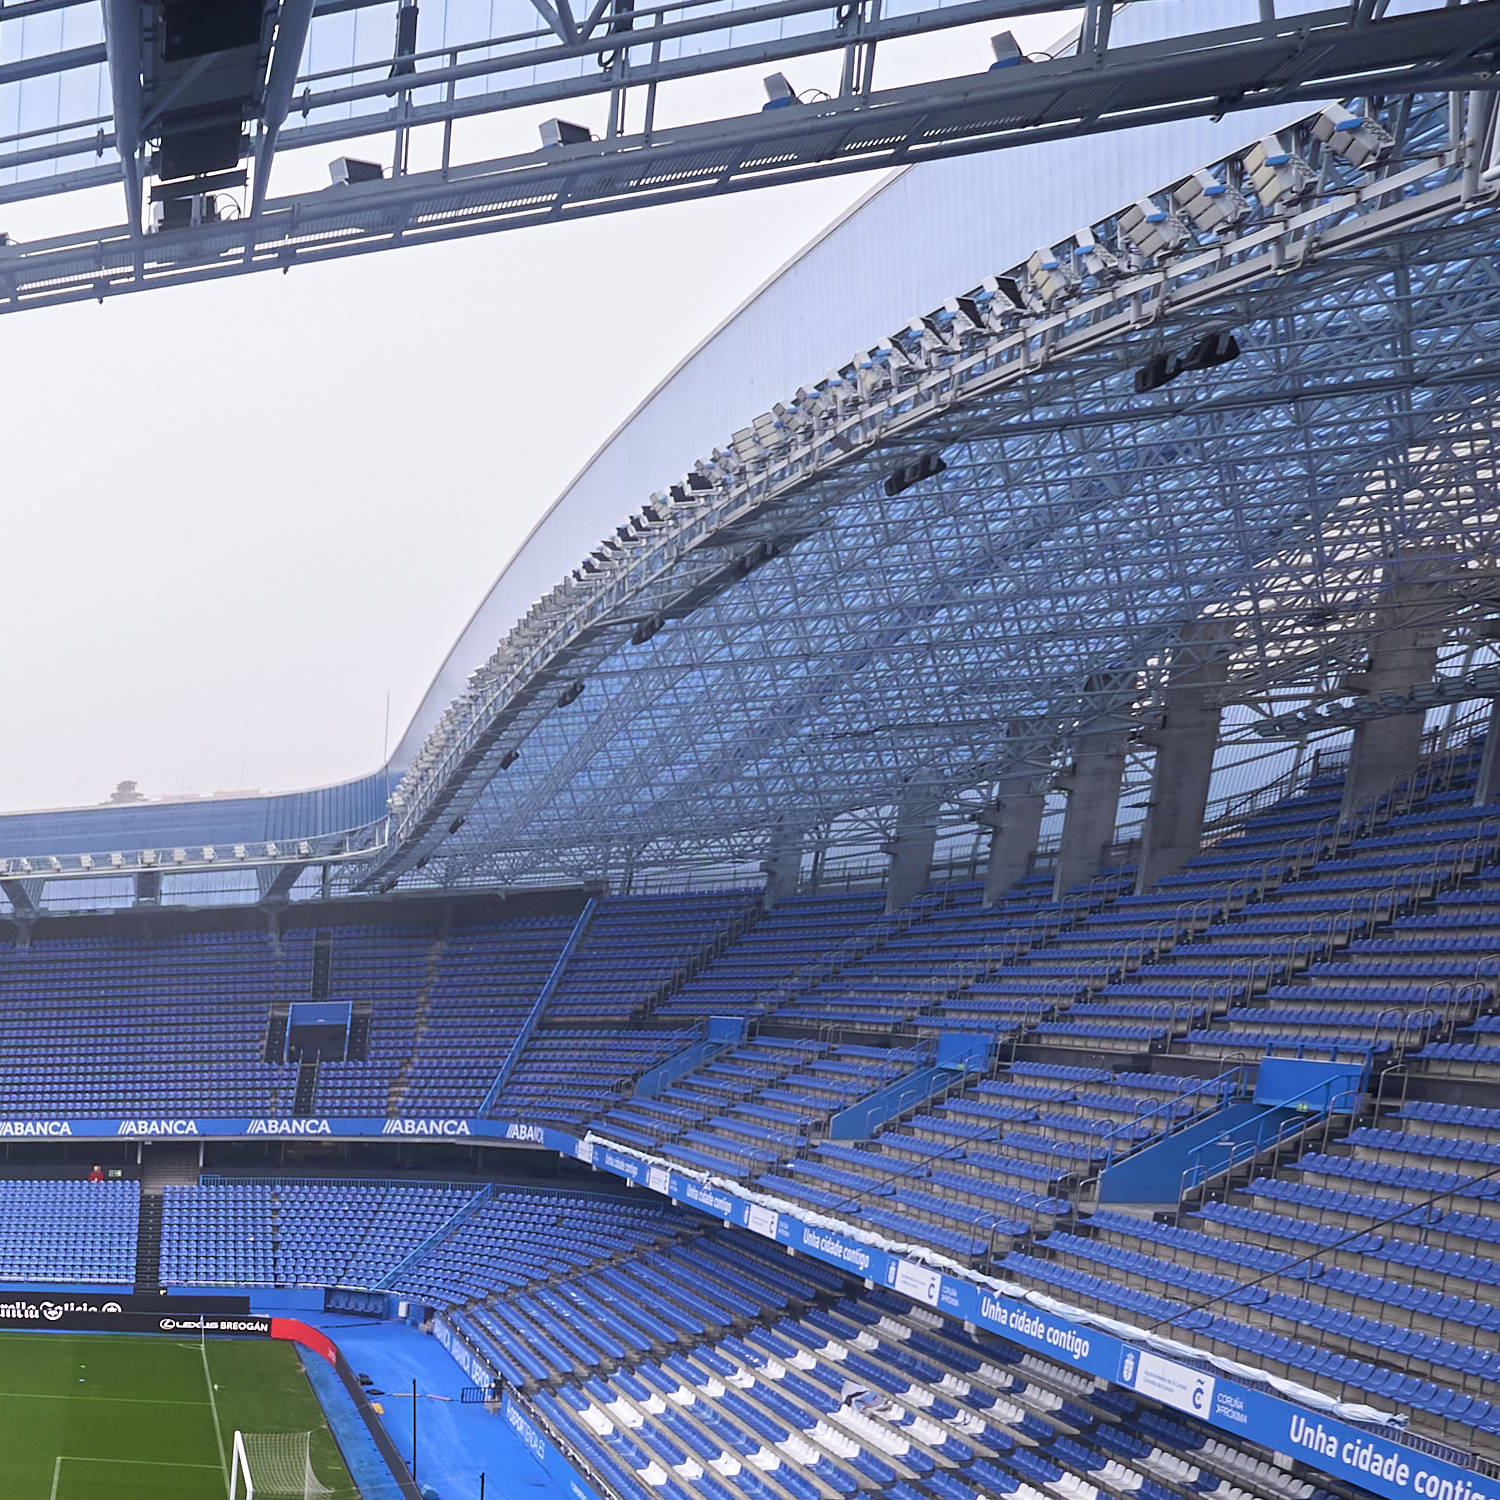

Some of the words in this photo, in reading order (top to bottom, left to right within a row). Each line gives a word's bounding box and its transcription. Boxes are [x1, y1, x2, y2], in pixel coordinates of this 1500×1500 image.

[802, 1228, 821, 1246] Unha
[821, 1232, 843, 1257] cidade
[843, 1244, 870, 1271] contigo
[220, 1321, 268, 1332] BREOGÁN
[981, 1299, 1008, 1324] Unha
[1009, 1308, 1044, 1340] cidade
[1046, 1327, 1090, 1360] contigo
[1290, 1414, 1338, 1458] Unha
[1342, 1439, 1410, 1486] cidade
